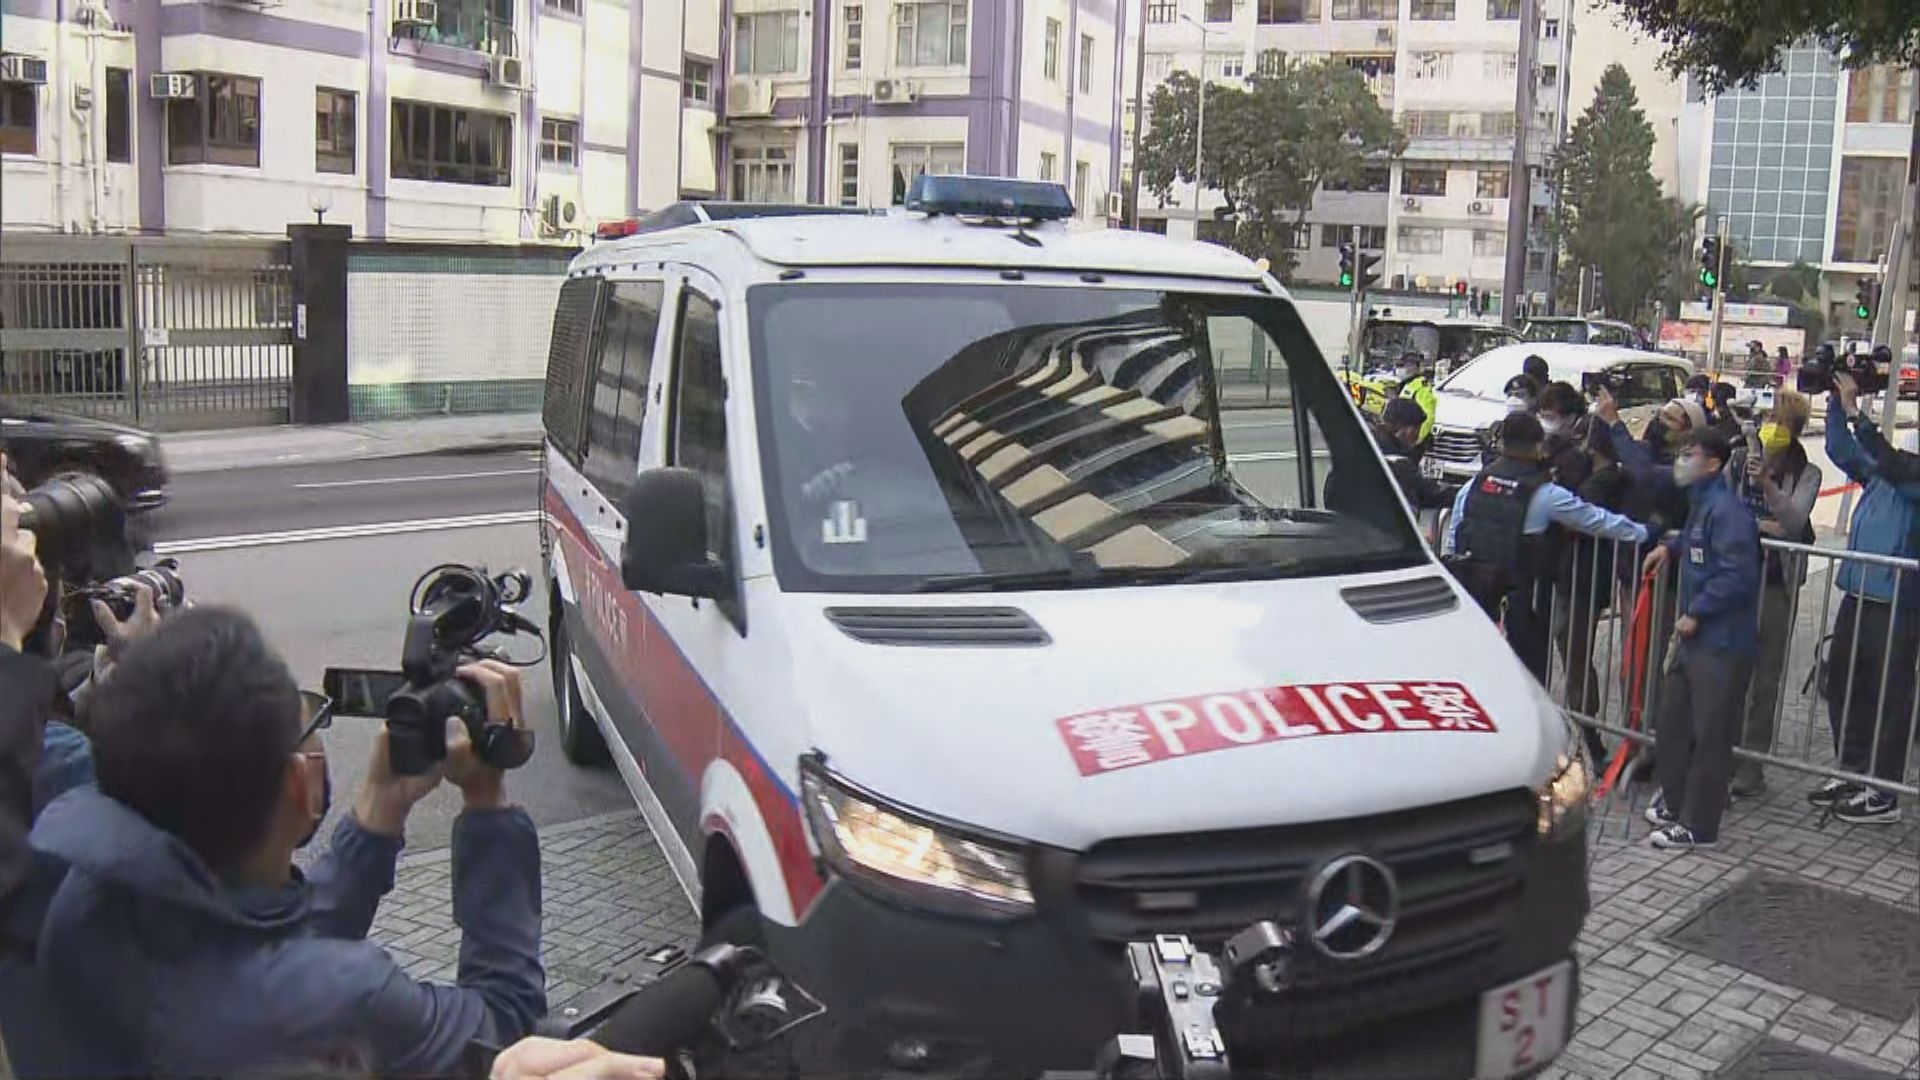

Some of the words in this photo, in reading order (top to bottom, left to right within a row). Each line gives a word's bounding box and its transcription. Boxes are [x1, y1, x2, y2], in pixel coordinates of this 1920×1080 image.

[1142, 683, 1431, 754] POLICE
[1500, 976, 1552, 1032] ST
[1512, 1024, 1536, 1069] 2
